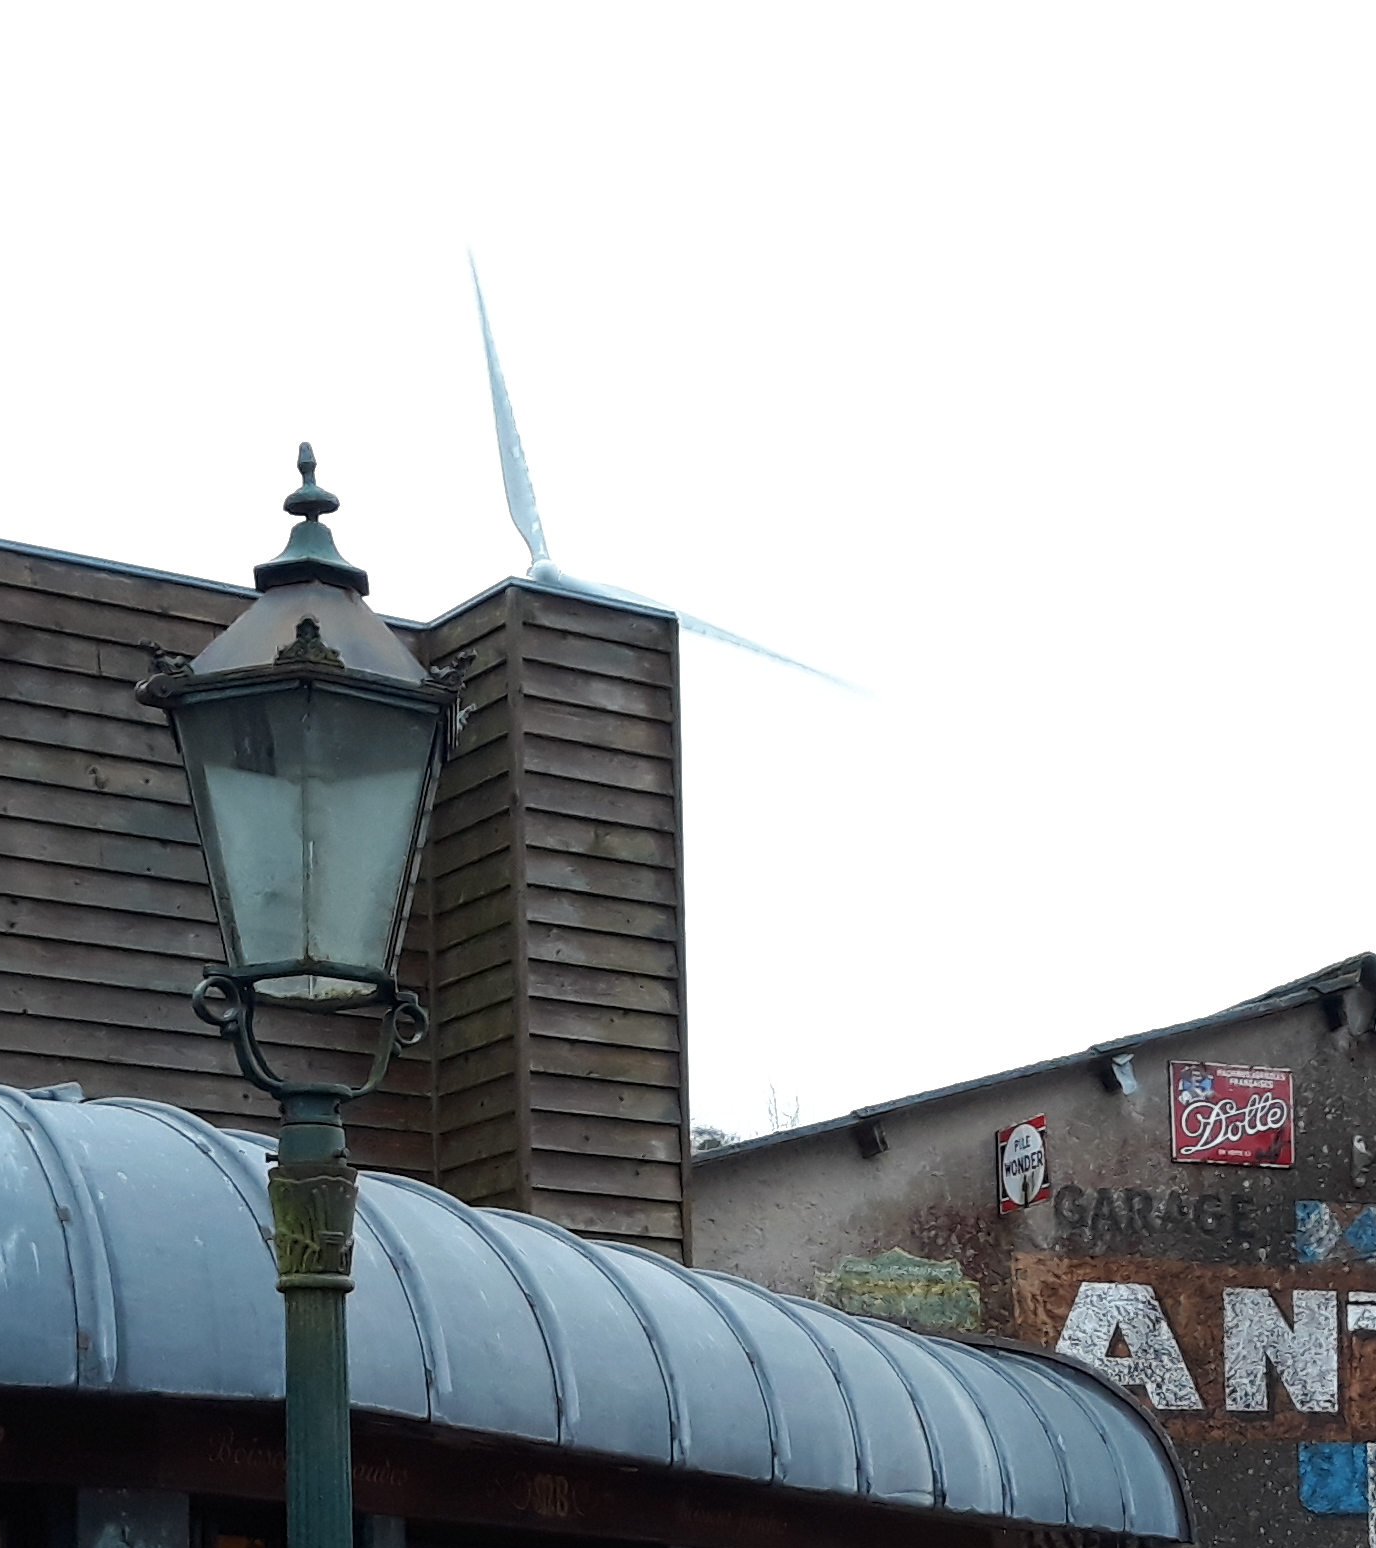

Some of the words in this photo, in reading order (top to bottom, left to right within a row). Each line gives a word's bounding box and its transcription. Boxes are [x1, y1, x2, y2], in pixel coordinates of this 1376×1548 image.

[1014, 1135, 1031, 1152] PILE
[1005, 1150, 1043, 1177] WONDER
[1054, 1184, 1255, 1238] GARAGE
